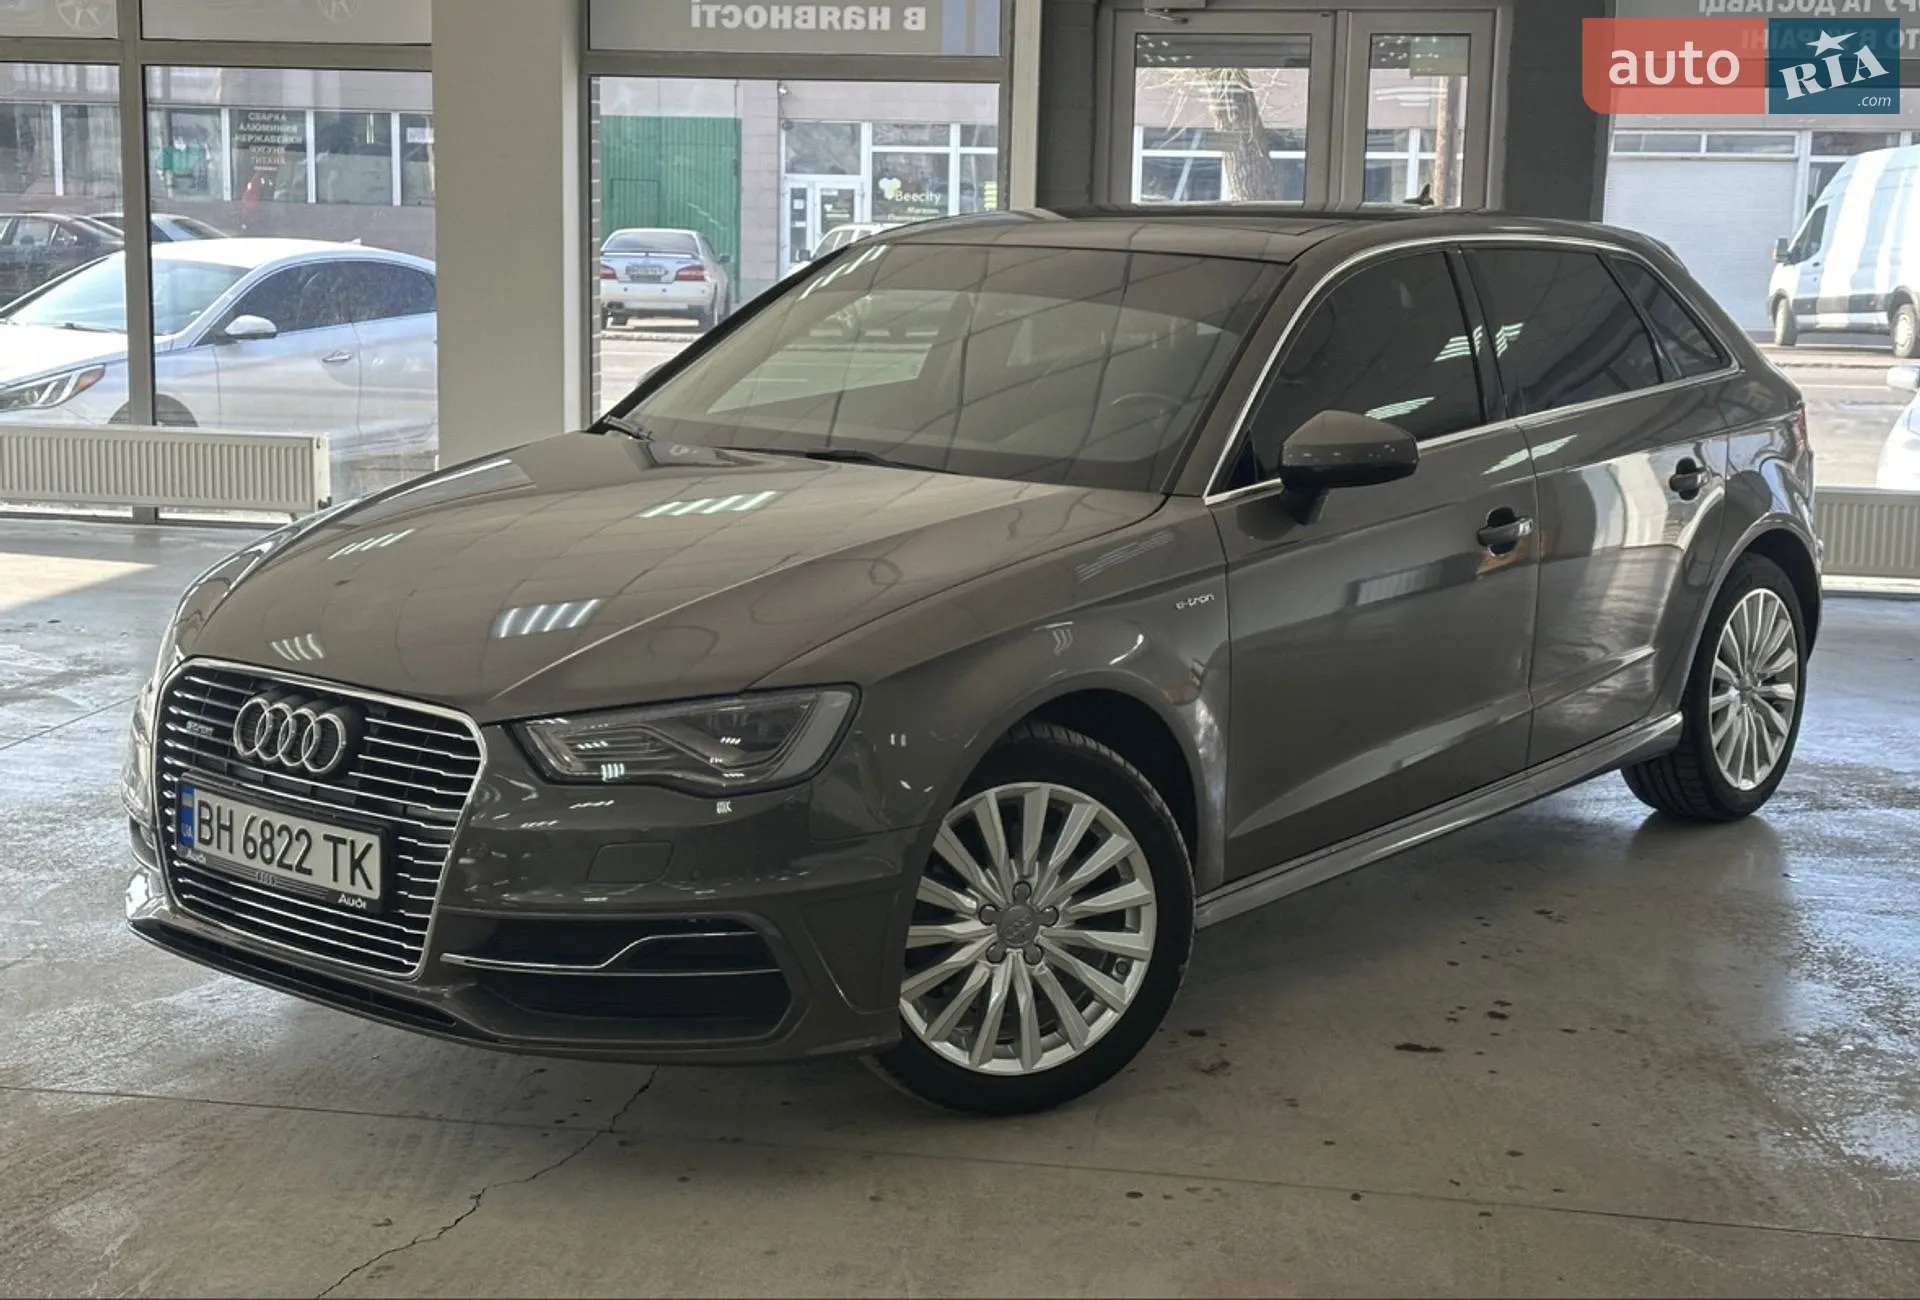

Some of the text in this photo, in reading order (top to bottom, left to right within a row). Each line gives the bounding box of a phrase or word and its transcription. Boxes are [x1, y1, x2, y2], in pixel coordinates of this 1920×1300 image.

[895, 190, 941, 205] Beecity
[198, 800, 374, 890] BH 6822 TK
[338, 893, 367, 909] Audi
